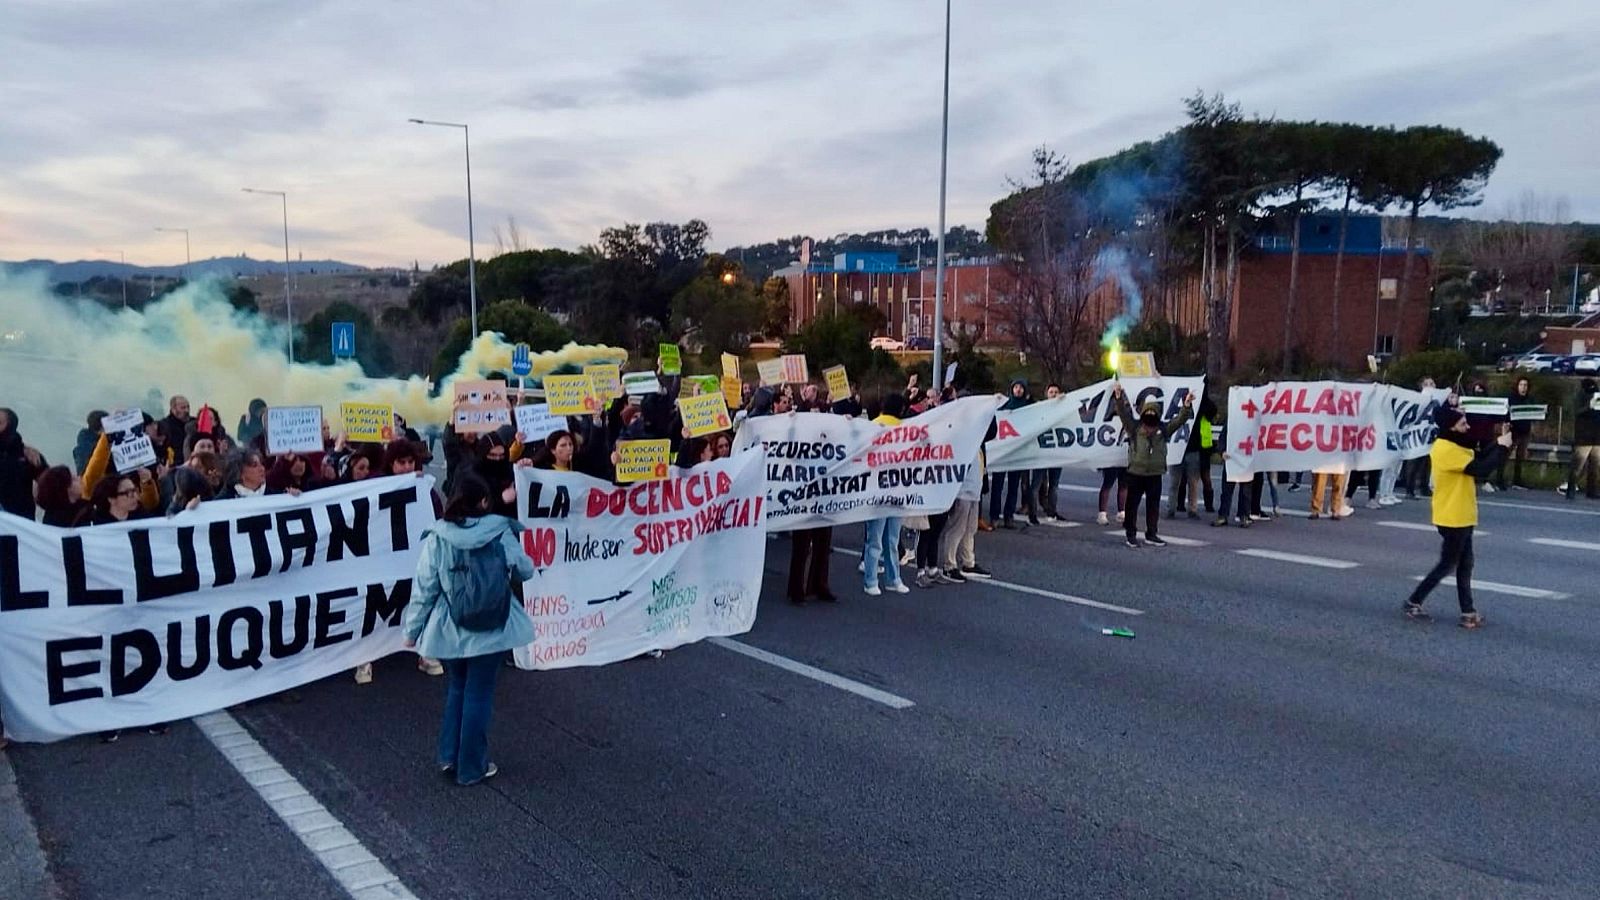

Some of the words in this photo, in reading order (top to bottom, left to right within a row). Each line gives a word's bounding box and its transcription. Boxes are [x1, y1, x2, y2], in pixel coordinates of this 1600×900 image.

[878, 463, 972, 489] EDUCATIV
[528, 481, 571, 519] LA
[0, 486, 418, 612] LLUITANT
[522, 527, 556, 568] NO
[601, 538, 625, 560] ser
[46, 578, 413, 706] EDUQUEM
